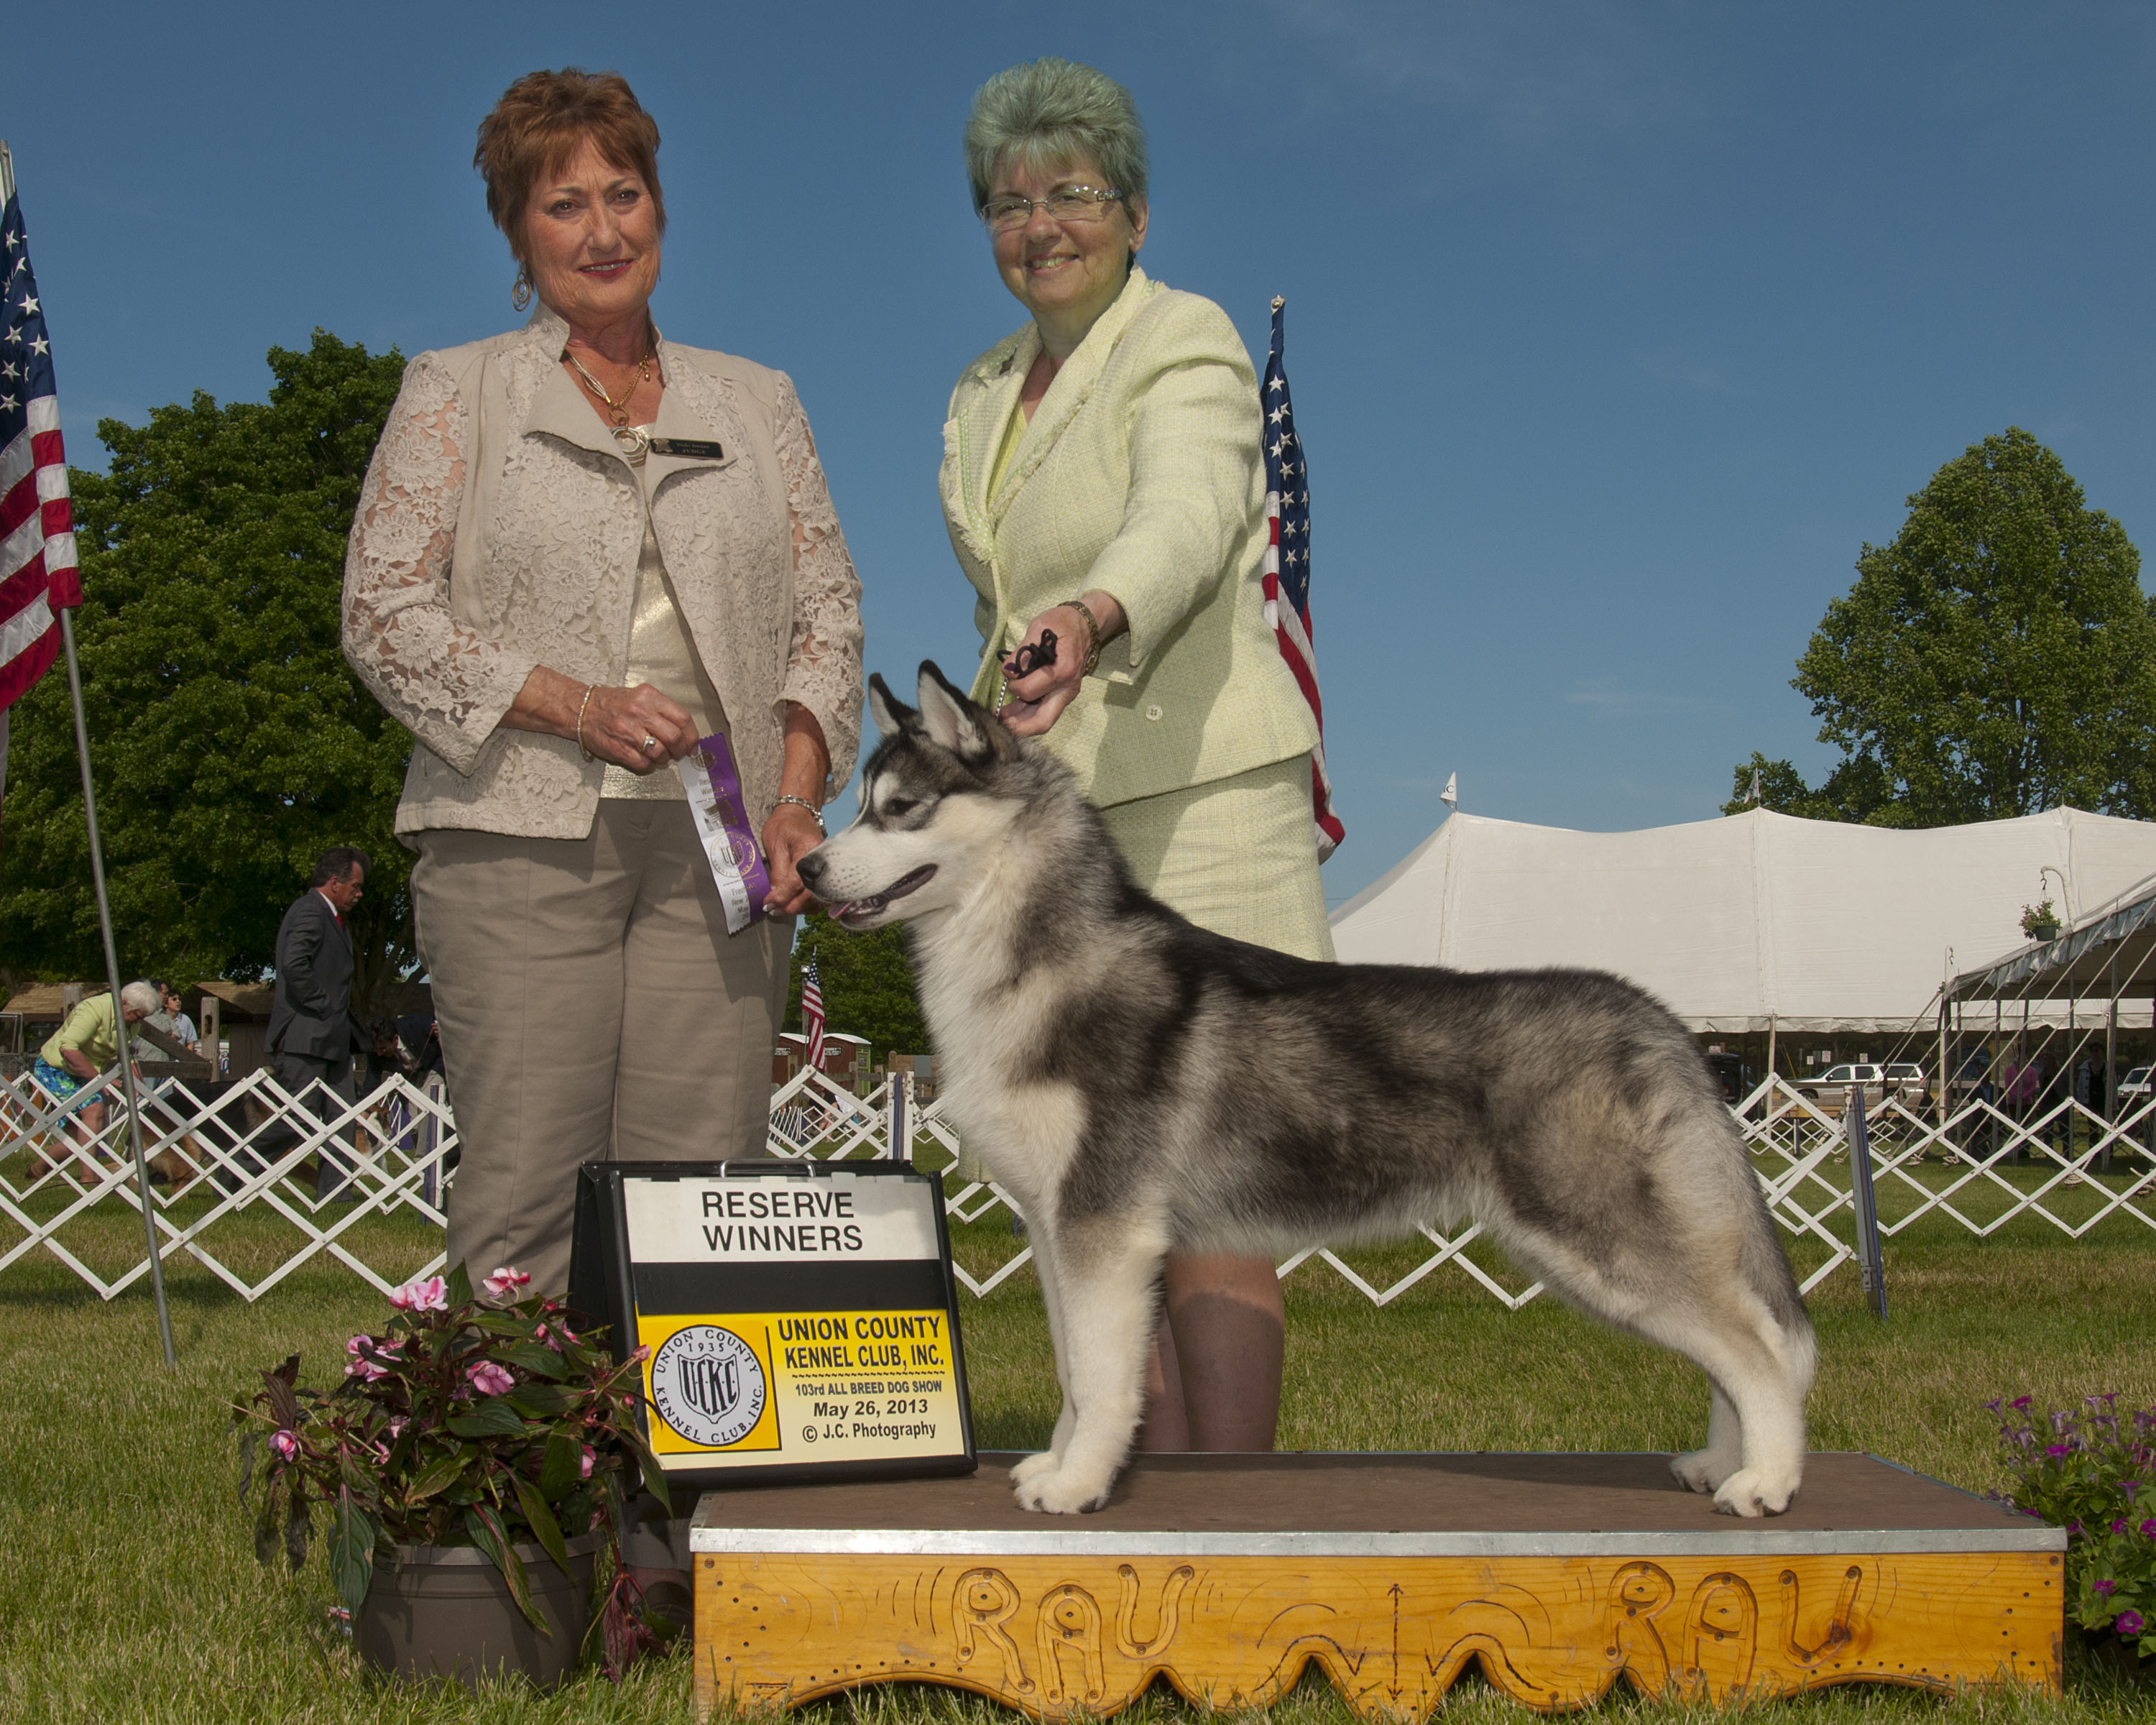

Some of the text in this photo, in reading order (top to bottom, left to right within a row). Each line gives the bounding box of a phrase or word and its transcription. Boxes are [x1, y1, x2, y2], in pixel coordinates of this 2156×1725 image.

[701, 1191, 854, 1219] RESERVE
[702, 1224, 863, 1251] WINNERS
[778, 1315, 940, 1341] UNION COUNTY
[656, 1329, 758, 1374] UNION COUNTY
[688, 1343, 724, 1353] 1935
[784, 1344, 944, 1370] KENNEL CLUB, INC.
[796, 1380, 942, 1397] 103rd ALL BREED DOG SHOW
[656, 1384, 762, 1443] KENNEL CLUB, INC.
[814, 1399, 929, 1420] May 26, 2013
[823, 1423, 849, 1438] J.C.
[852, 1420, 936, 1440] Photography
